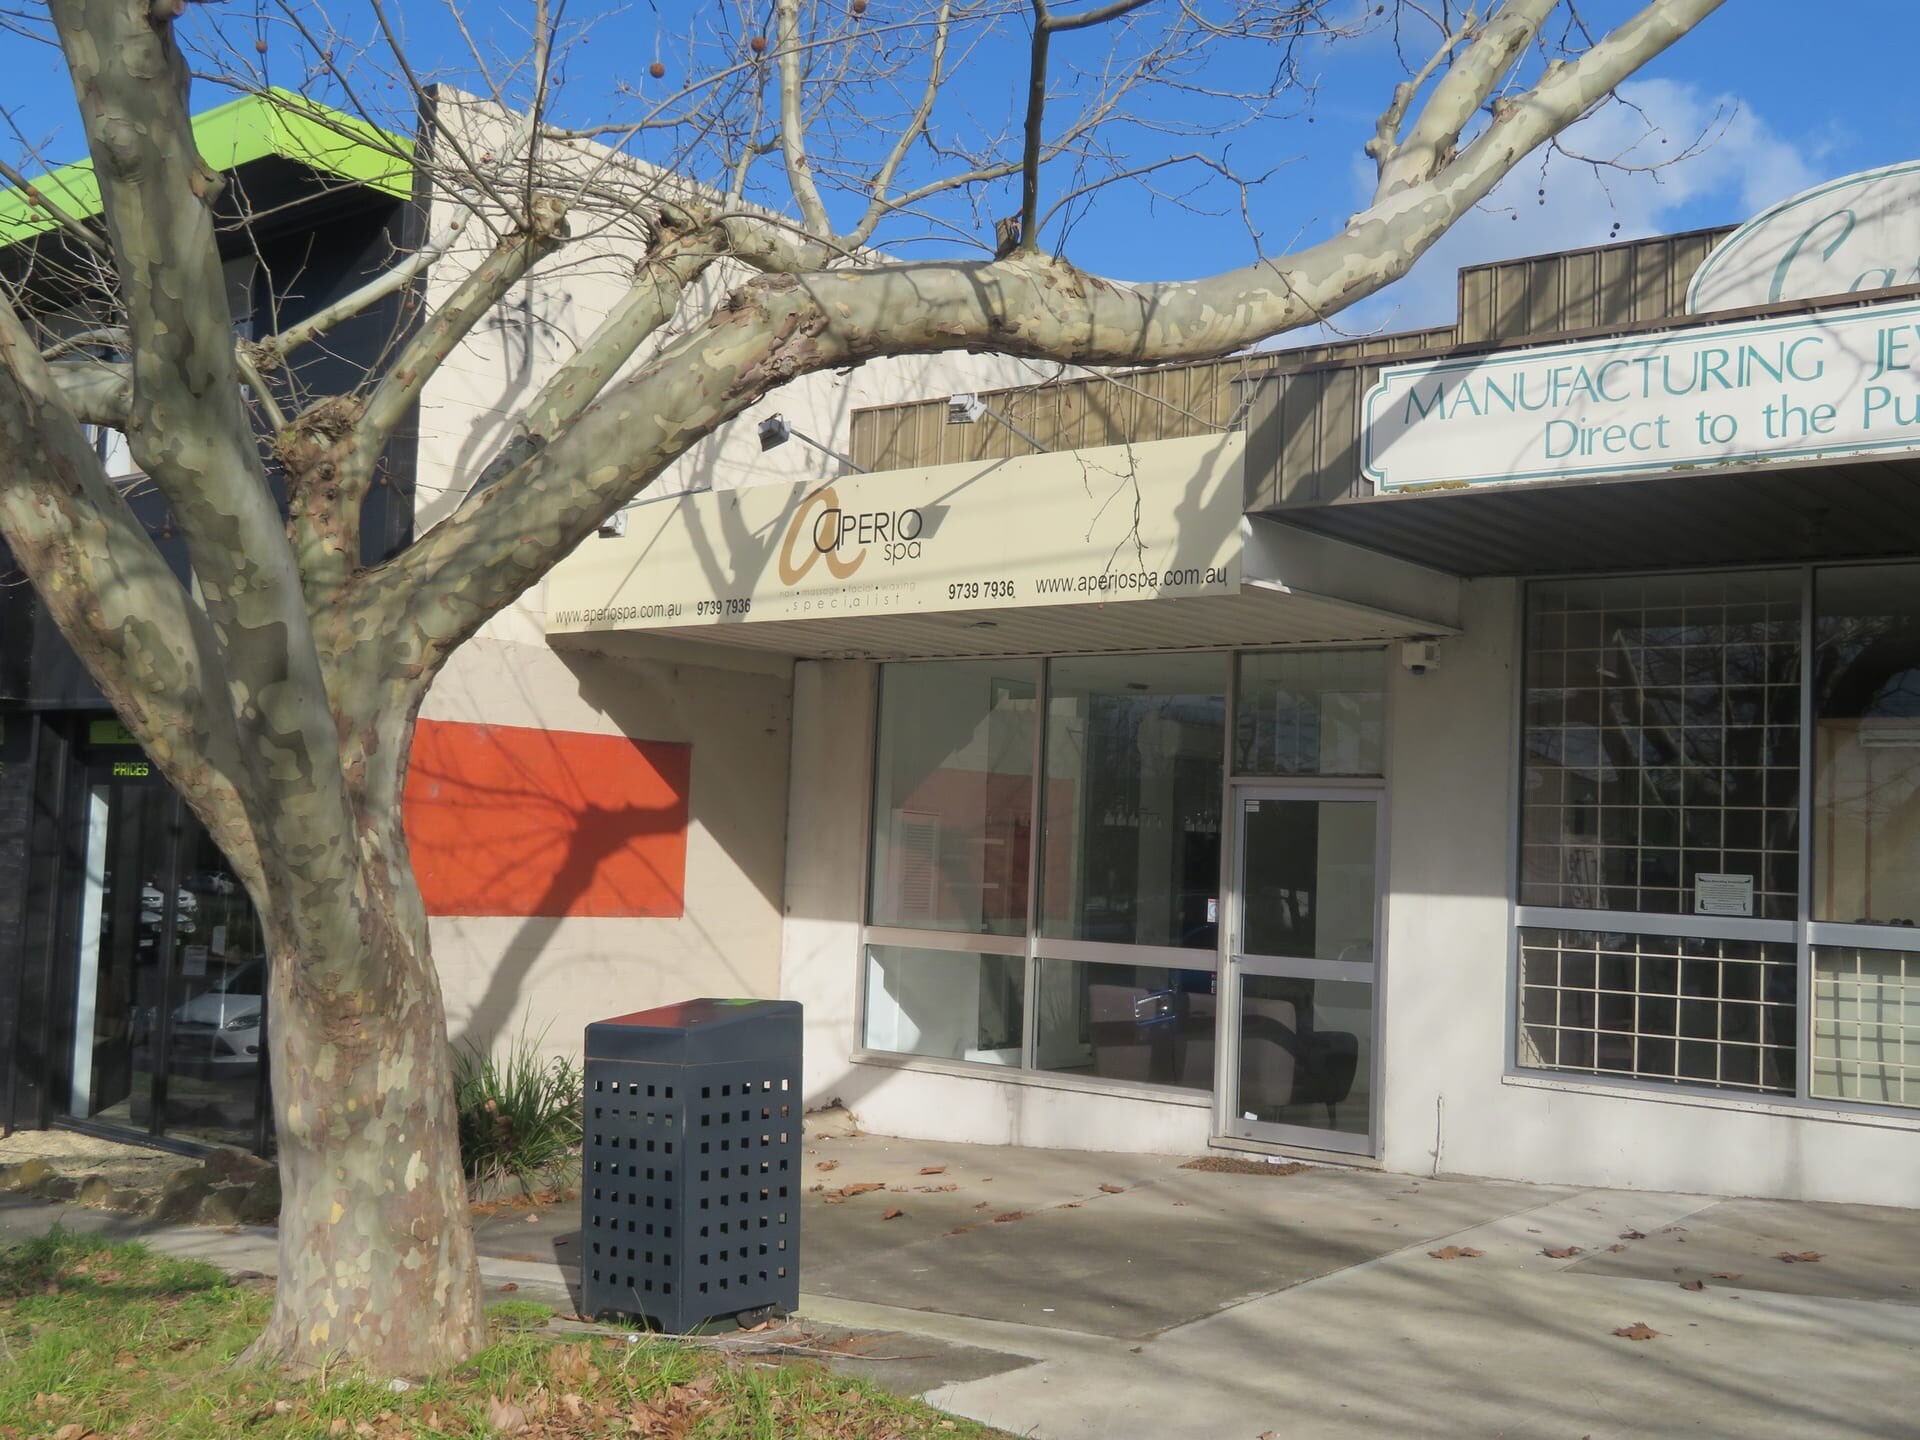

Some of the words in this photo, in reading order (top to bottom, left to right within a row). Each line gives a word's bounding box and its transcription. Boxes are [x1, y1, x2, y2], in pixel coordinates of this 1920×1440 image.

[1404, 336, 1824, 424] MANUFACTURING
[1868, 312, 1920, 382] JE
[1545, 414, 1671, 459] Direct
[1696, 410, 1738, 446] to
[1762, 393, 1837, 439] the
[883, 540, 922, 566] spa
[948, 581, 979, 600] 9739
[983, 579, 1015, 599] 7936
[1035, 567, 1228, 596] www.aperiospa.com.au
[555, 602, 682, 626] www.aperiospa.com.au
[697, 600, 722, 616] 9739
[726, 597, 751, 616] 7936
[793, 593, 900, 612] specialist
[112, 761, 149, 776] PRICES
